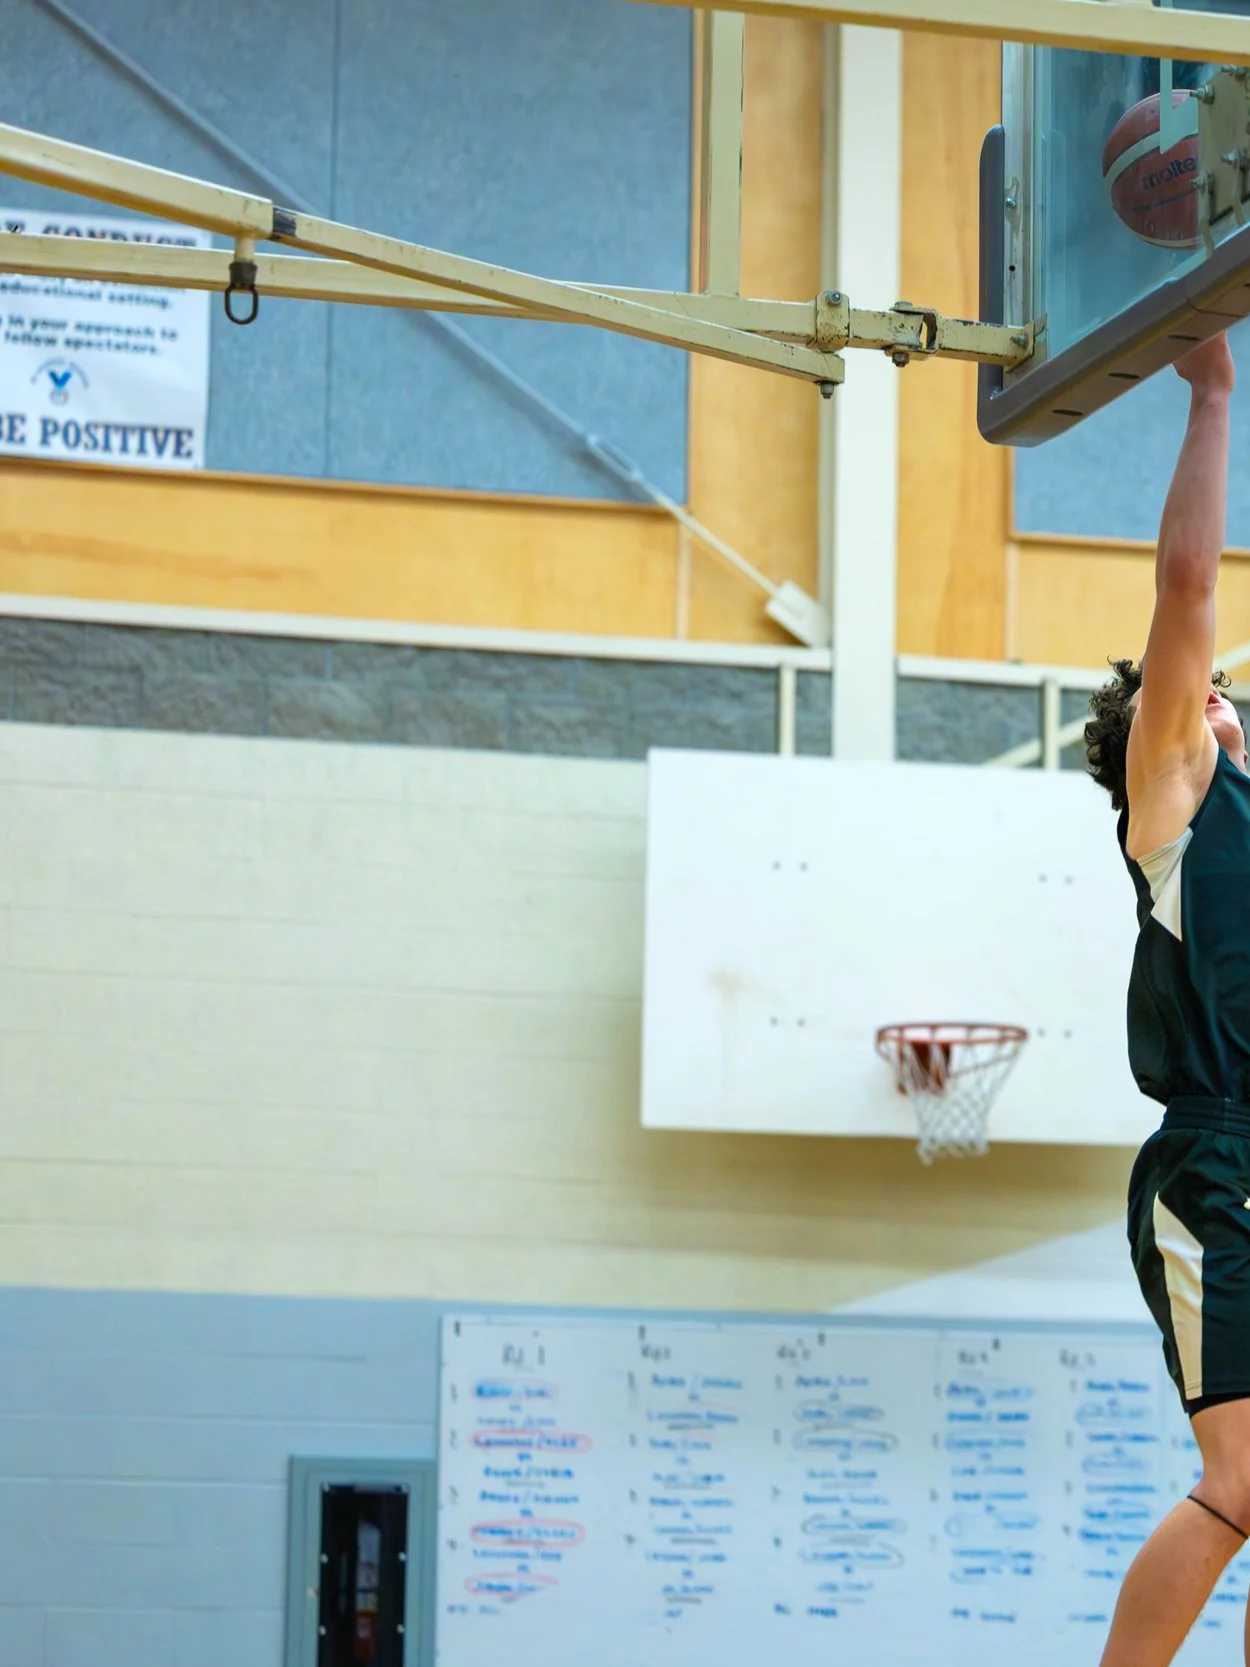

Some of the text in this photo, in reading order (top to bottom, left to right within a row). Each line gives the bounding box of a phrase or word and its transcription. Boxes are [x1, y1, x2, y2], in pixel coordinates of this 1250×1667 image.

[1142, 157, 1198, 189] molte
[0, 412, 194, 459] E POSITIVE
